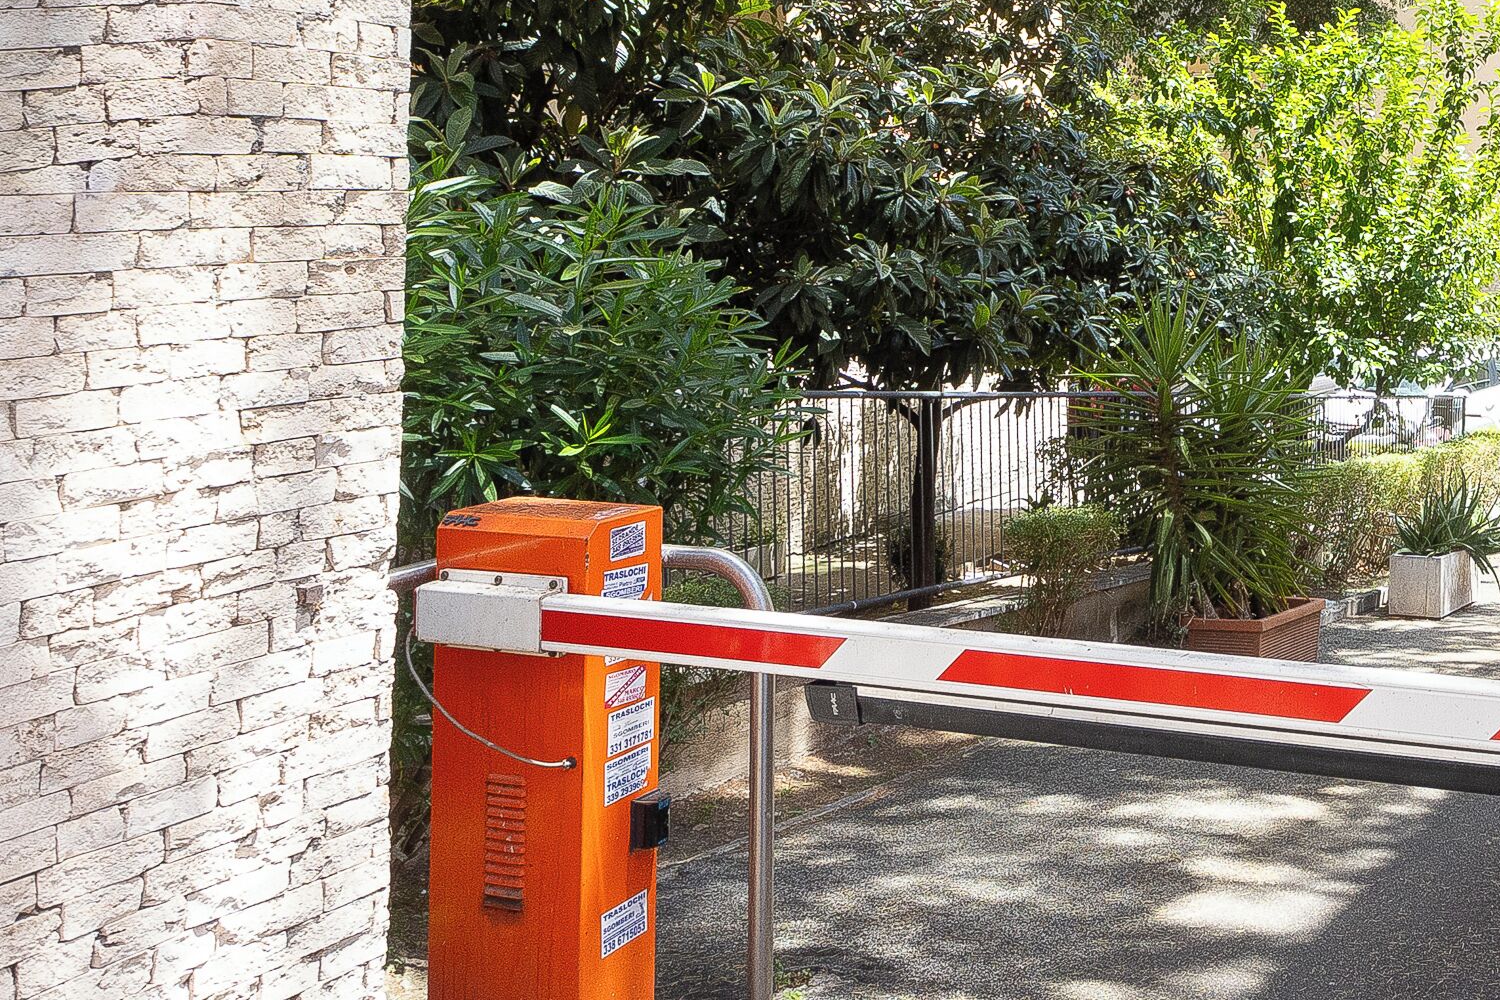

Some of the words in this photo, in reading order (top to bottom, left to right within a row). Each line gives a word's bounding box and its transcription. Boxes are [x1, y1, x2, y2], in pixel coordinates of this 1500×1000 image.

[604, 565, 647, 582] TRASLOCHI
[606, 584, 643, 598] SGOMBERI
[611, 699, 653, 721] TRASLOCHI
[613, 719, 650, 739] SGOMBERI
[606, 746, 649, 771] SGOMBERI
[602, 891, 646, 922] TRASLOCHI
[603, 910, 635, 936] SGOMBERI
